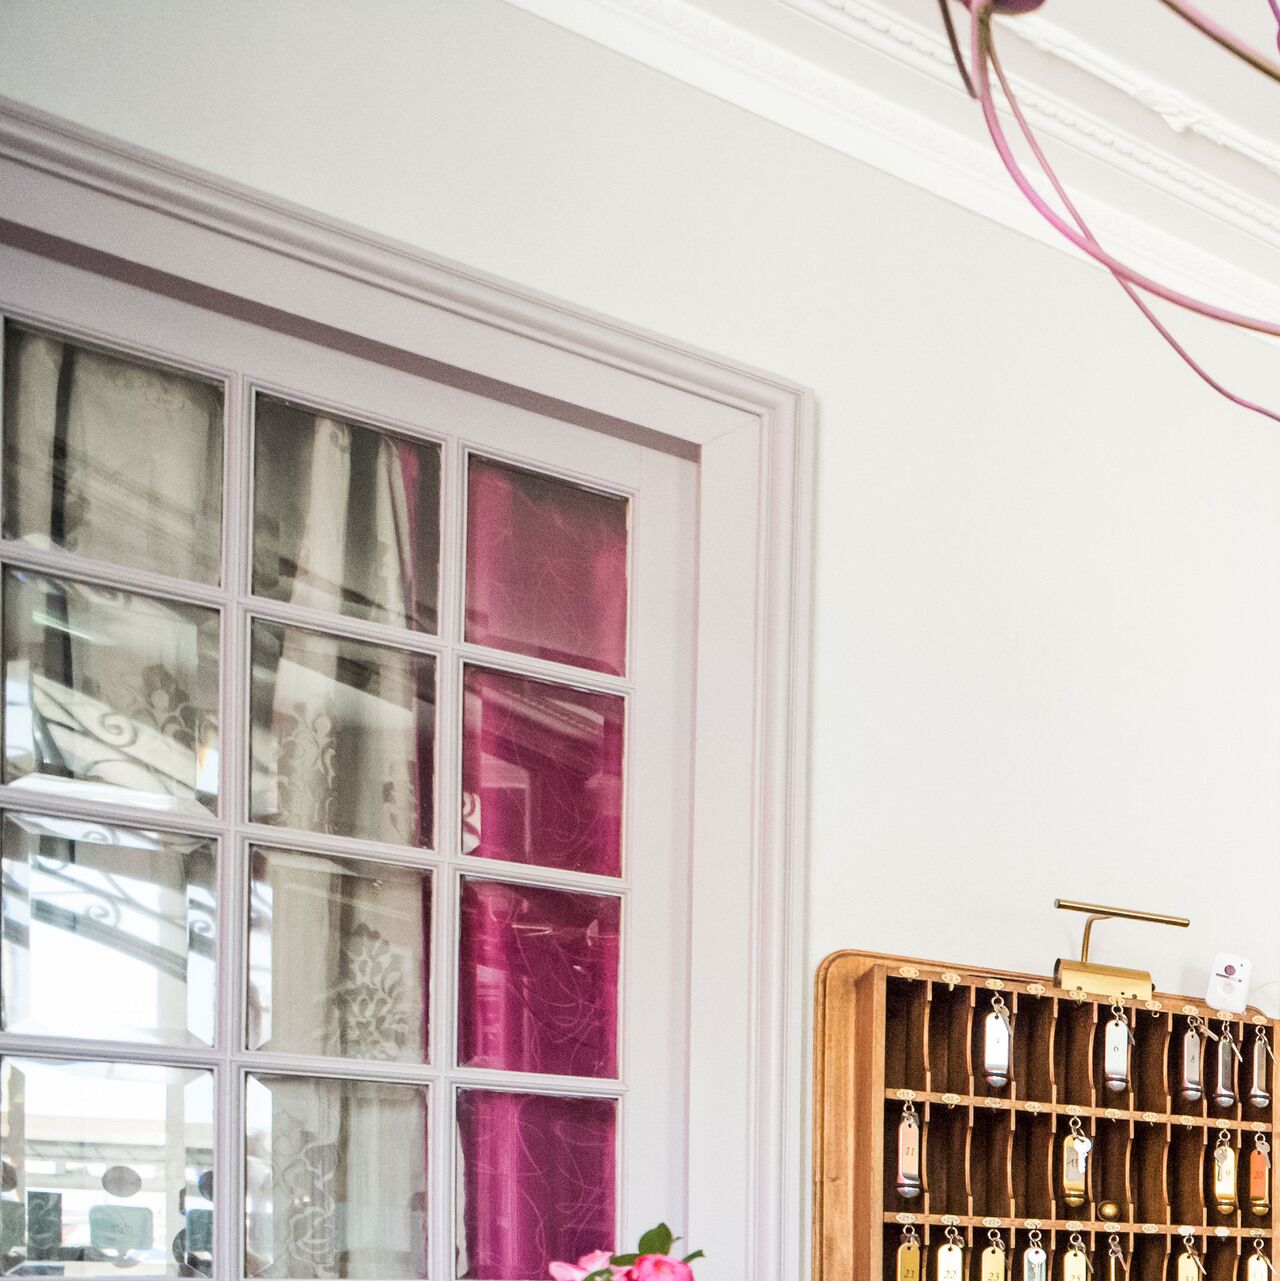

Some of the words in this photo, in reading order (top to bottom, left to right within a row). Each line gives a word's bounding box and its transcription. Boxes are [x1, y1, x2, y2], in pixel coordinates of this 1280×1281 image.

[903, 1269, 916, 1279] 21
[943, 1270, 958, 1280] 22
[986, 1272, 1000, 1281] 23
